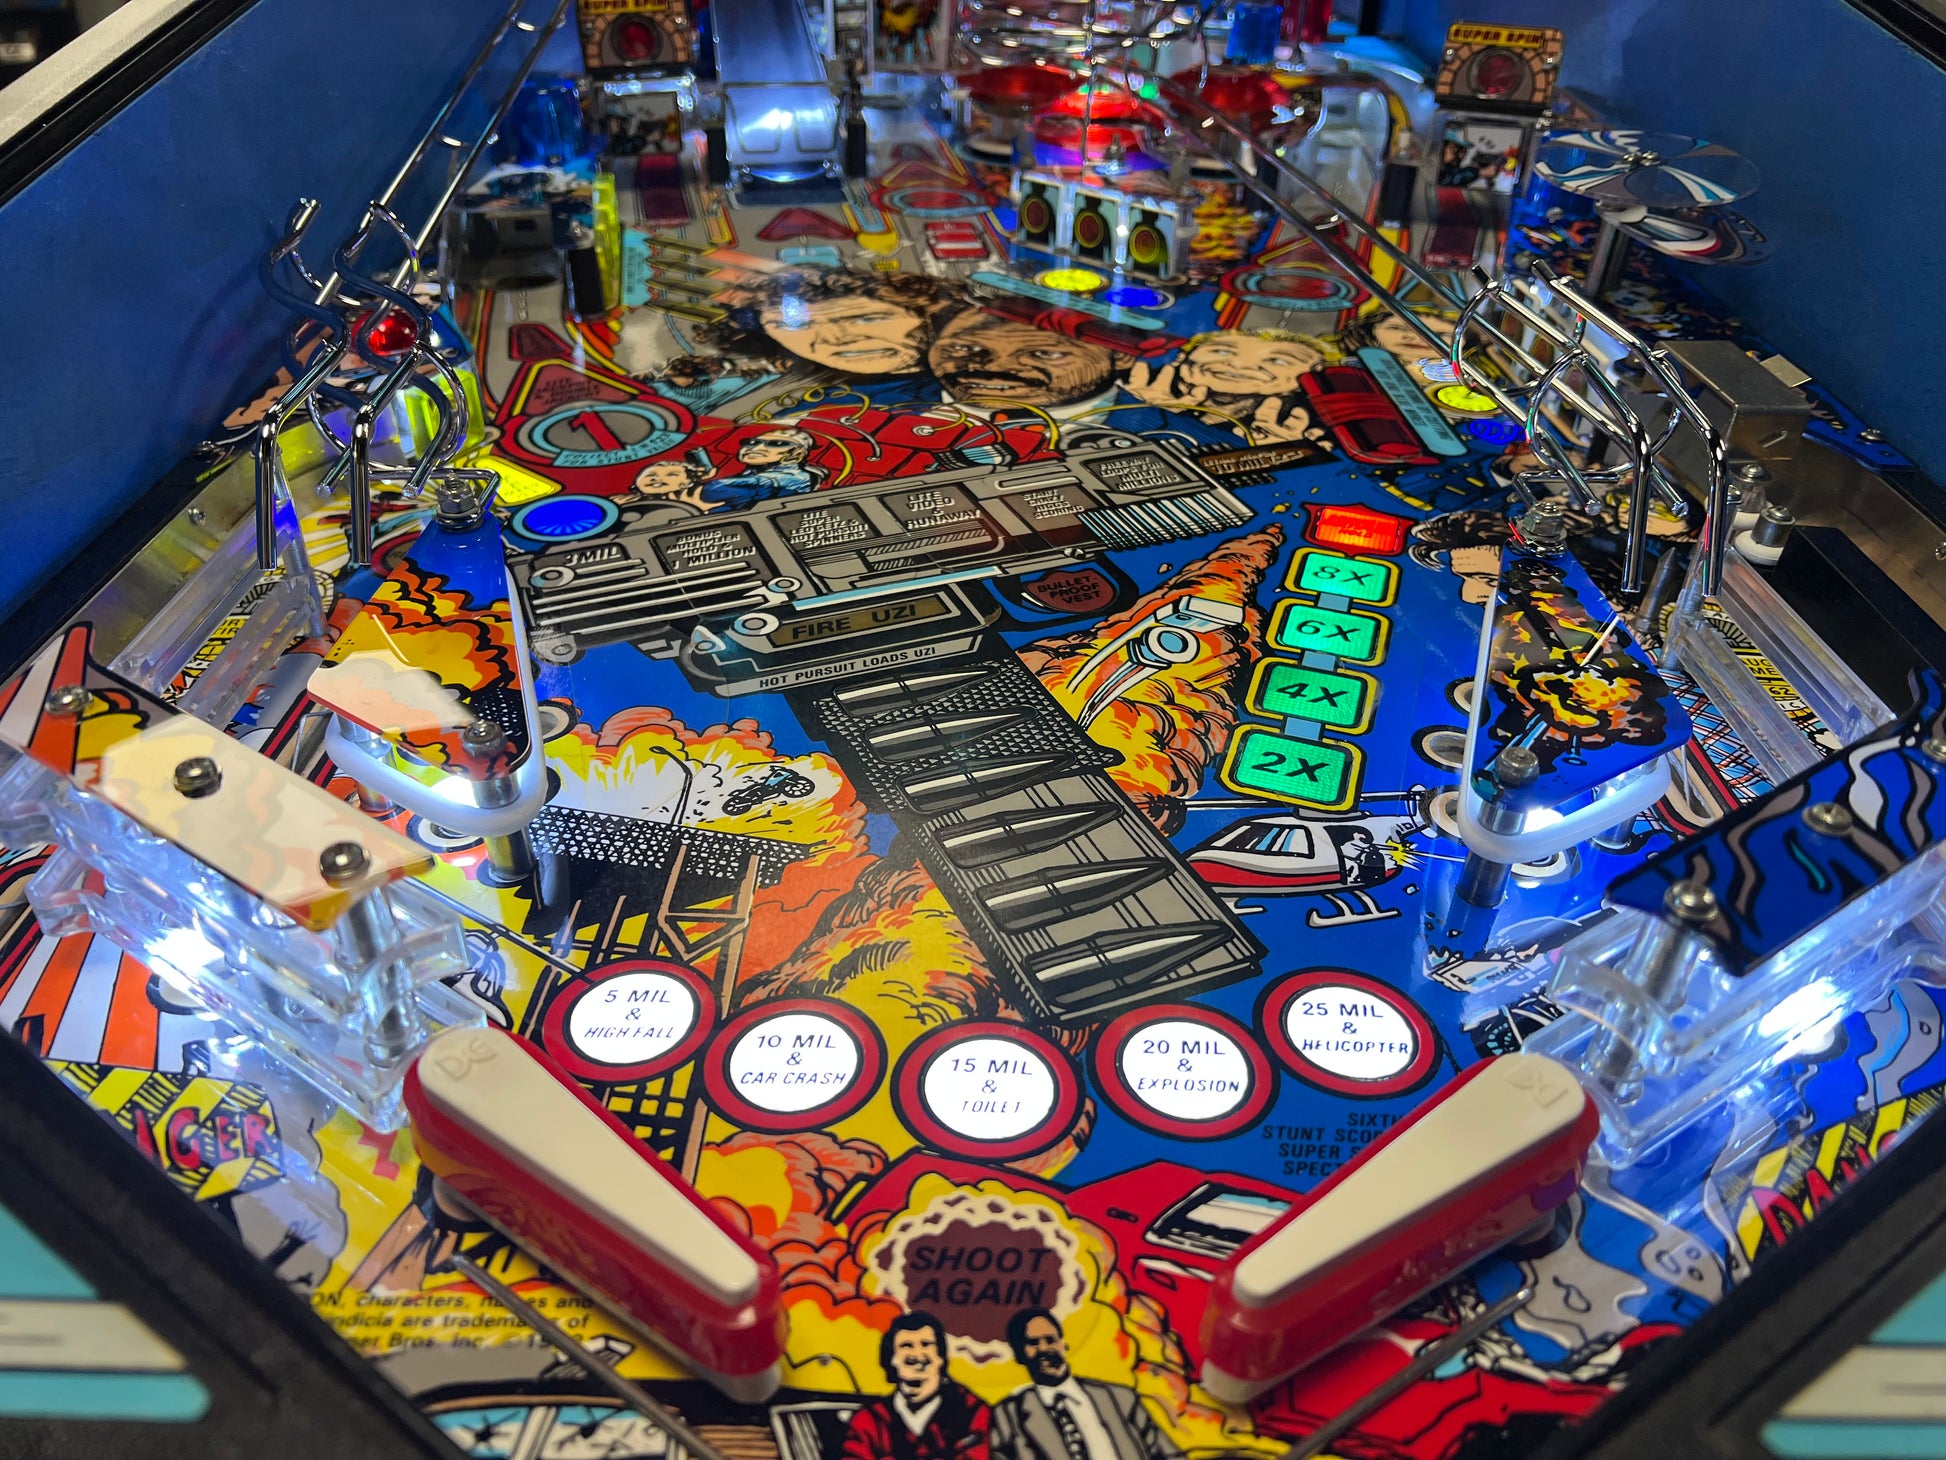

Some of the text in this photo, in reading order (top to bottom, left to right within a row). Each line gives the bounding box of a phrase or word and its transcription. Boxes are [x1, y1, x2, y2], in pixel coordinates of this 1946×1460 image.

[1453, 28, 1501, 41] SUPER
[1116, 474, 1180, 491] MILLIONS
[906, 497, 955, 512] VIDEO
[908, 491, 943, 504] LITE
[906, 509, 981, 530] RUNAWAY
[666, 534, 741, 554] MULTIPLIER
[677, 530, 722, 545] BONUS
[683, 545, 718, 558] HOLD
[687, 546, 756, 567] MILLION
[1313, 565, 1374, 586] 8X
[1050, 582, 1099, 598] PROOF
[1062, 591, 1101, 604] VEST
[792, 604, 916, 640] FIRE UZI
[1296, 620, 1360, 642] 6X
[759, 646, 937, 689] HOT PURSUIT LOADS UZI
[1276, 682, 1350, 708] 4X
[1251, 751, 1330, 783] 2X
[604, 989, 671, 1004] 5 MIL
[625, 1007, 642, 1021] &
[1302, 1002, 1384, 1018] 25 MIL
[584, 1026, 628, 1039] HIGH
[1341, 1021, 1358, 1034] &
[757, 1035, 837, 1049] 10 MIL
[1143, 1039, 1227, 1056] 20 MIL
[1302, 1038, 1409, 1054] HELICOPTER
[786, 1052, 803, 1066] &
[951, 1058, 1033, 1075] 15 MIL
[1177, 1058, 1193, 1073] &
[740, 1072, 847, 1085] CAR CRASH
[981, 1079, 998, 1093] &
[1137, 1077, 1240, 1093] EXPLOSION
[1262, 1125, 1326, 1141] STUNT
[1278, 1143, 1341, 1159] SUPER
[910, 1245, 1052, 1273] SHOOT
[911, 1278, 1047, 1306] AGAIN
[555, 1293, 594, 1309] and
[401, 1315, 433, 1328] are
[567, 1312, 590, 1329] of
